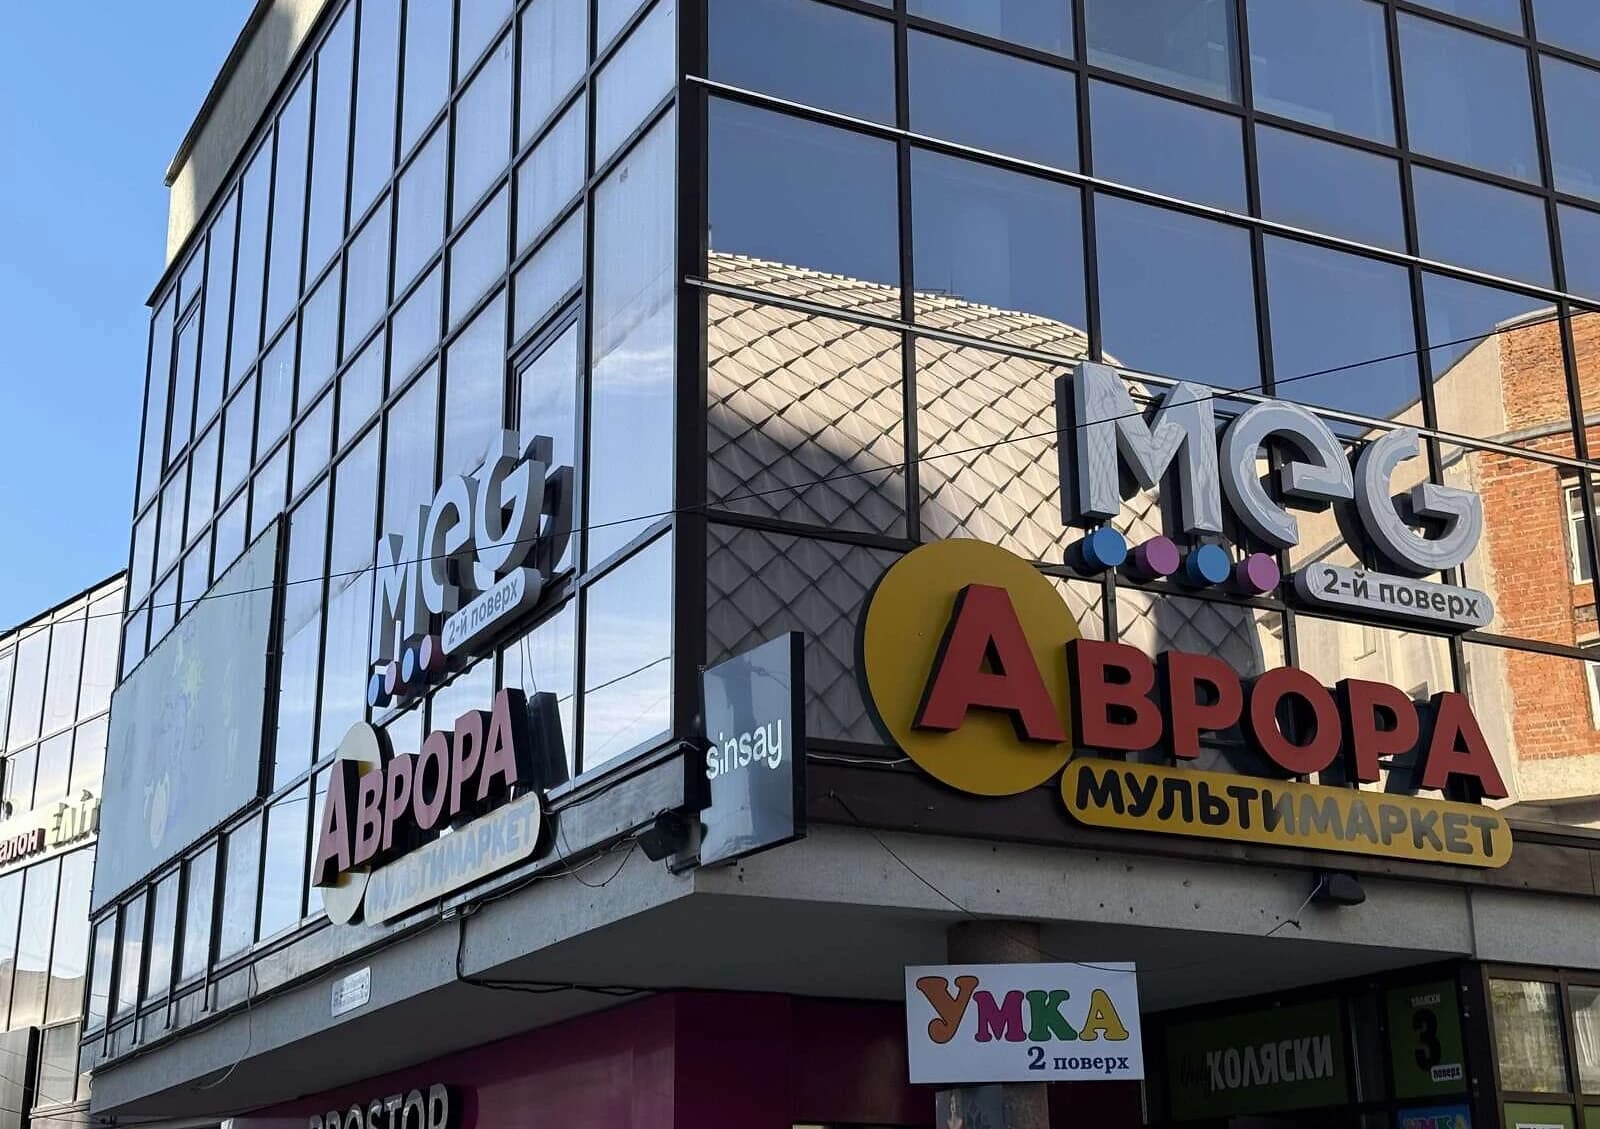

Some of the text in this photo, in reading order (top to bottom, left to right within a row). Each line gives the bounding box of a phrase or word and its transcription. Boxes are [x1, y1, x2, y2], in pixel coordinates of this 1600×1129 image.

[447, 578, 519, 643] 2-й поверх
[1322, 568, 1480, 619] 2-й поверх
[706, 719, 782, 780] sinsay
[1075, 764, 1500, 858] МУЛЬТИМАРКЕТ
[916, 976, 1129, 1044] УМКА
[1412, 1008, 1441, 1072] 3
[1027, 1046, 1129, 1074] 2 поверх
[1206, 1034, 1334, 1091] КОЛЯСКИ
